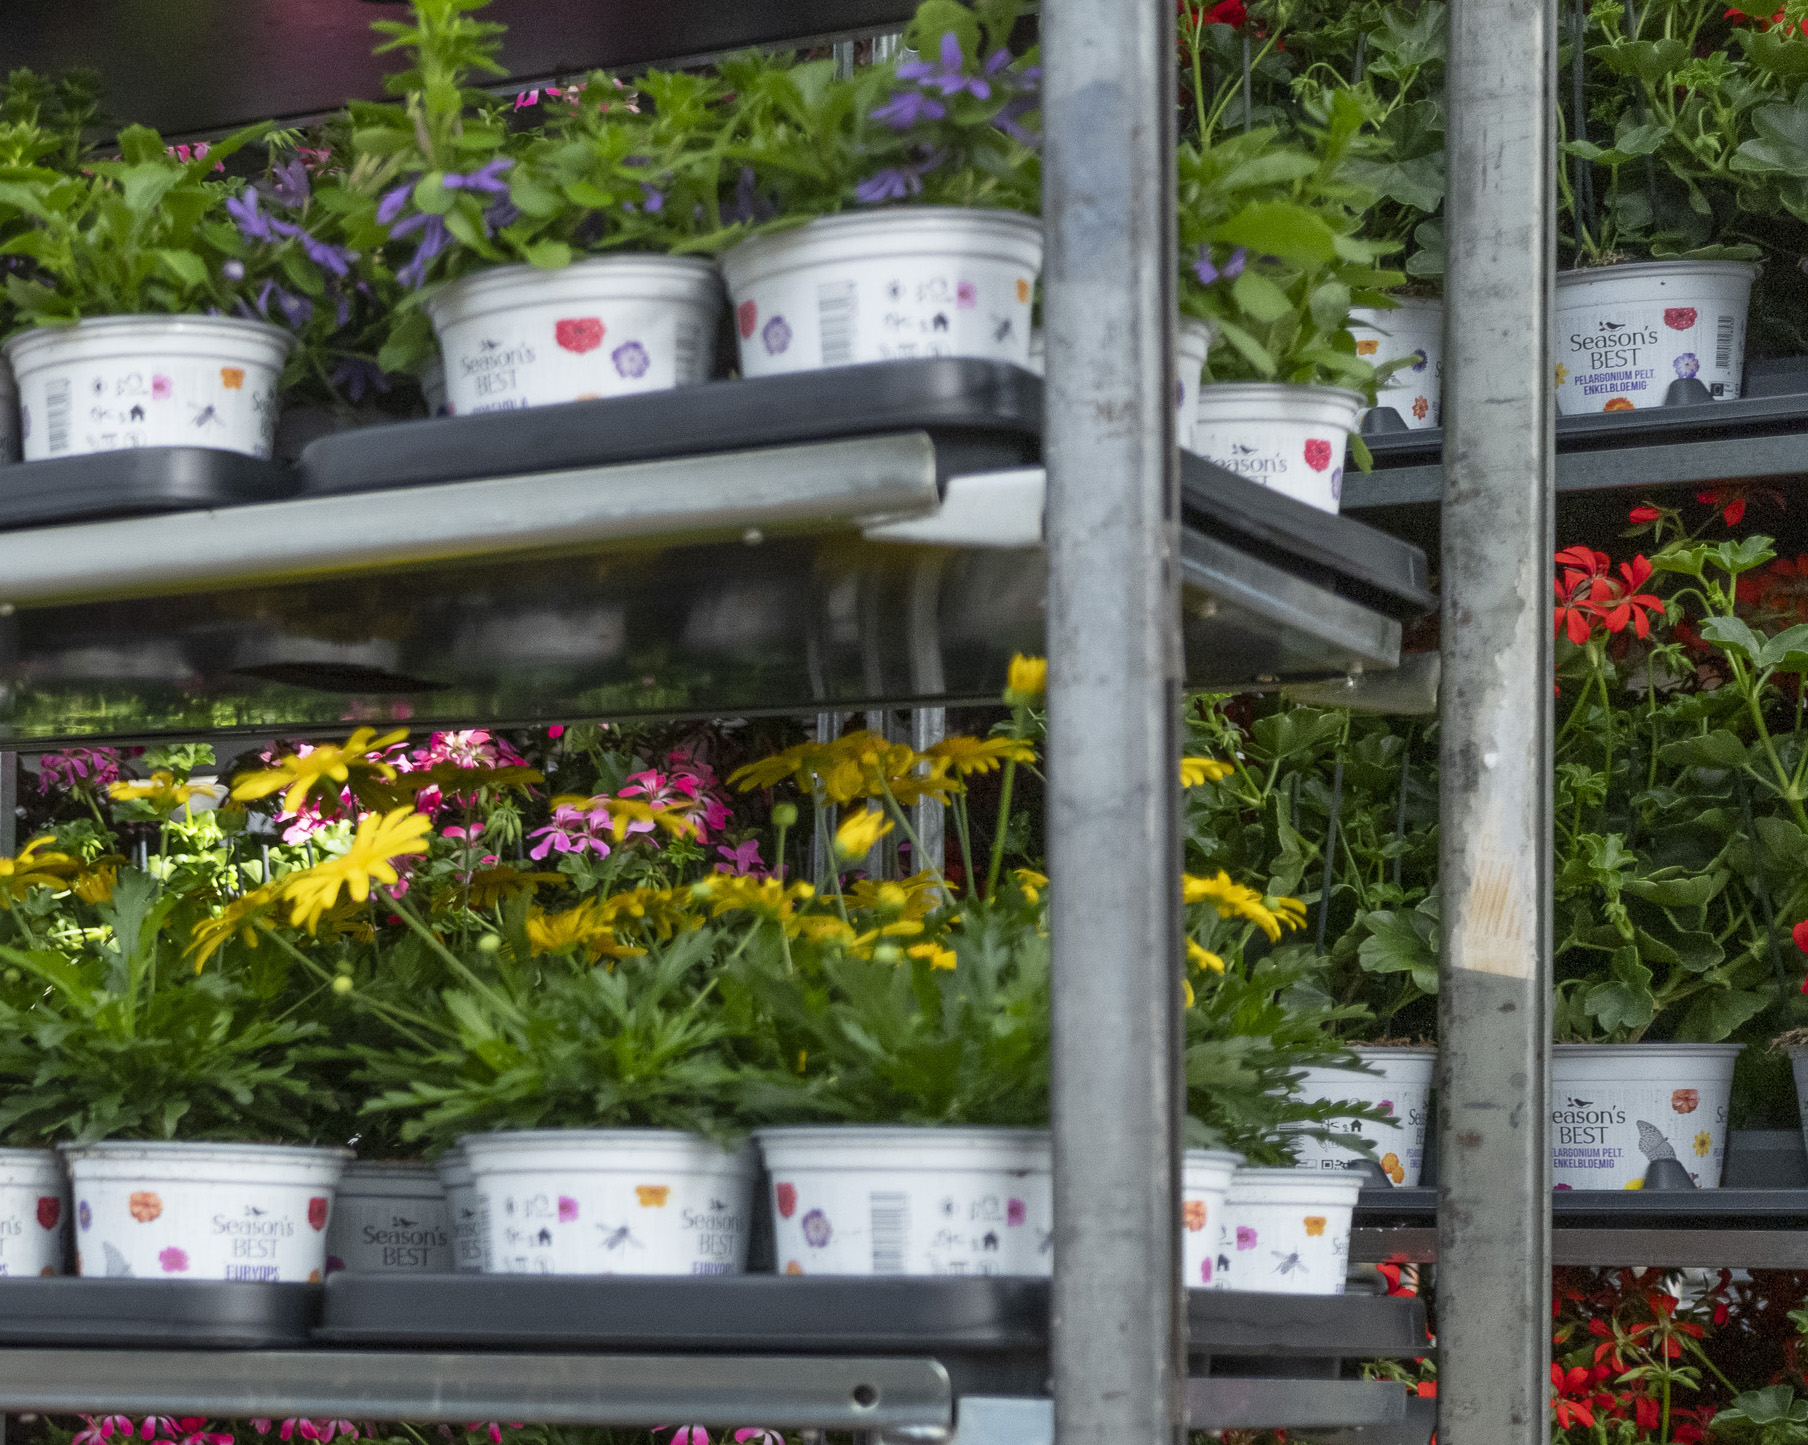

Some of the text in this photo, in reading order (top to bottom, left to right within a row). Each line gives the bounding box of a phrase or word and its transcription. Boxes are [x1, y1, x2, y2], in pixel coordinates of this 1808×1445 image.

[1570, 329, 1658, 352] Season's
[462, 344, 535, 375] Season's
[1590, 349, 1641, 369] BEST
[476, 370, 518, 395] BEST
[1574, 370, 1635, 385] PELARGONIUM
[1583, 380, 1649, 396] ENKELBLOEMIG
[1552, 1108, 1626, 1125] eason's
[1559, 1127, 1608, 1144] BEST
[1552, 1148, 1602, 1158] LARGONIUM
[213, 1215, 293, 1237] Season's
[363, 1226, 447, 1247] Season's
[232, 1239, 276, 1259] BEST
[383, 1248, 428, 1266] BEST
